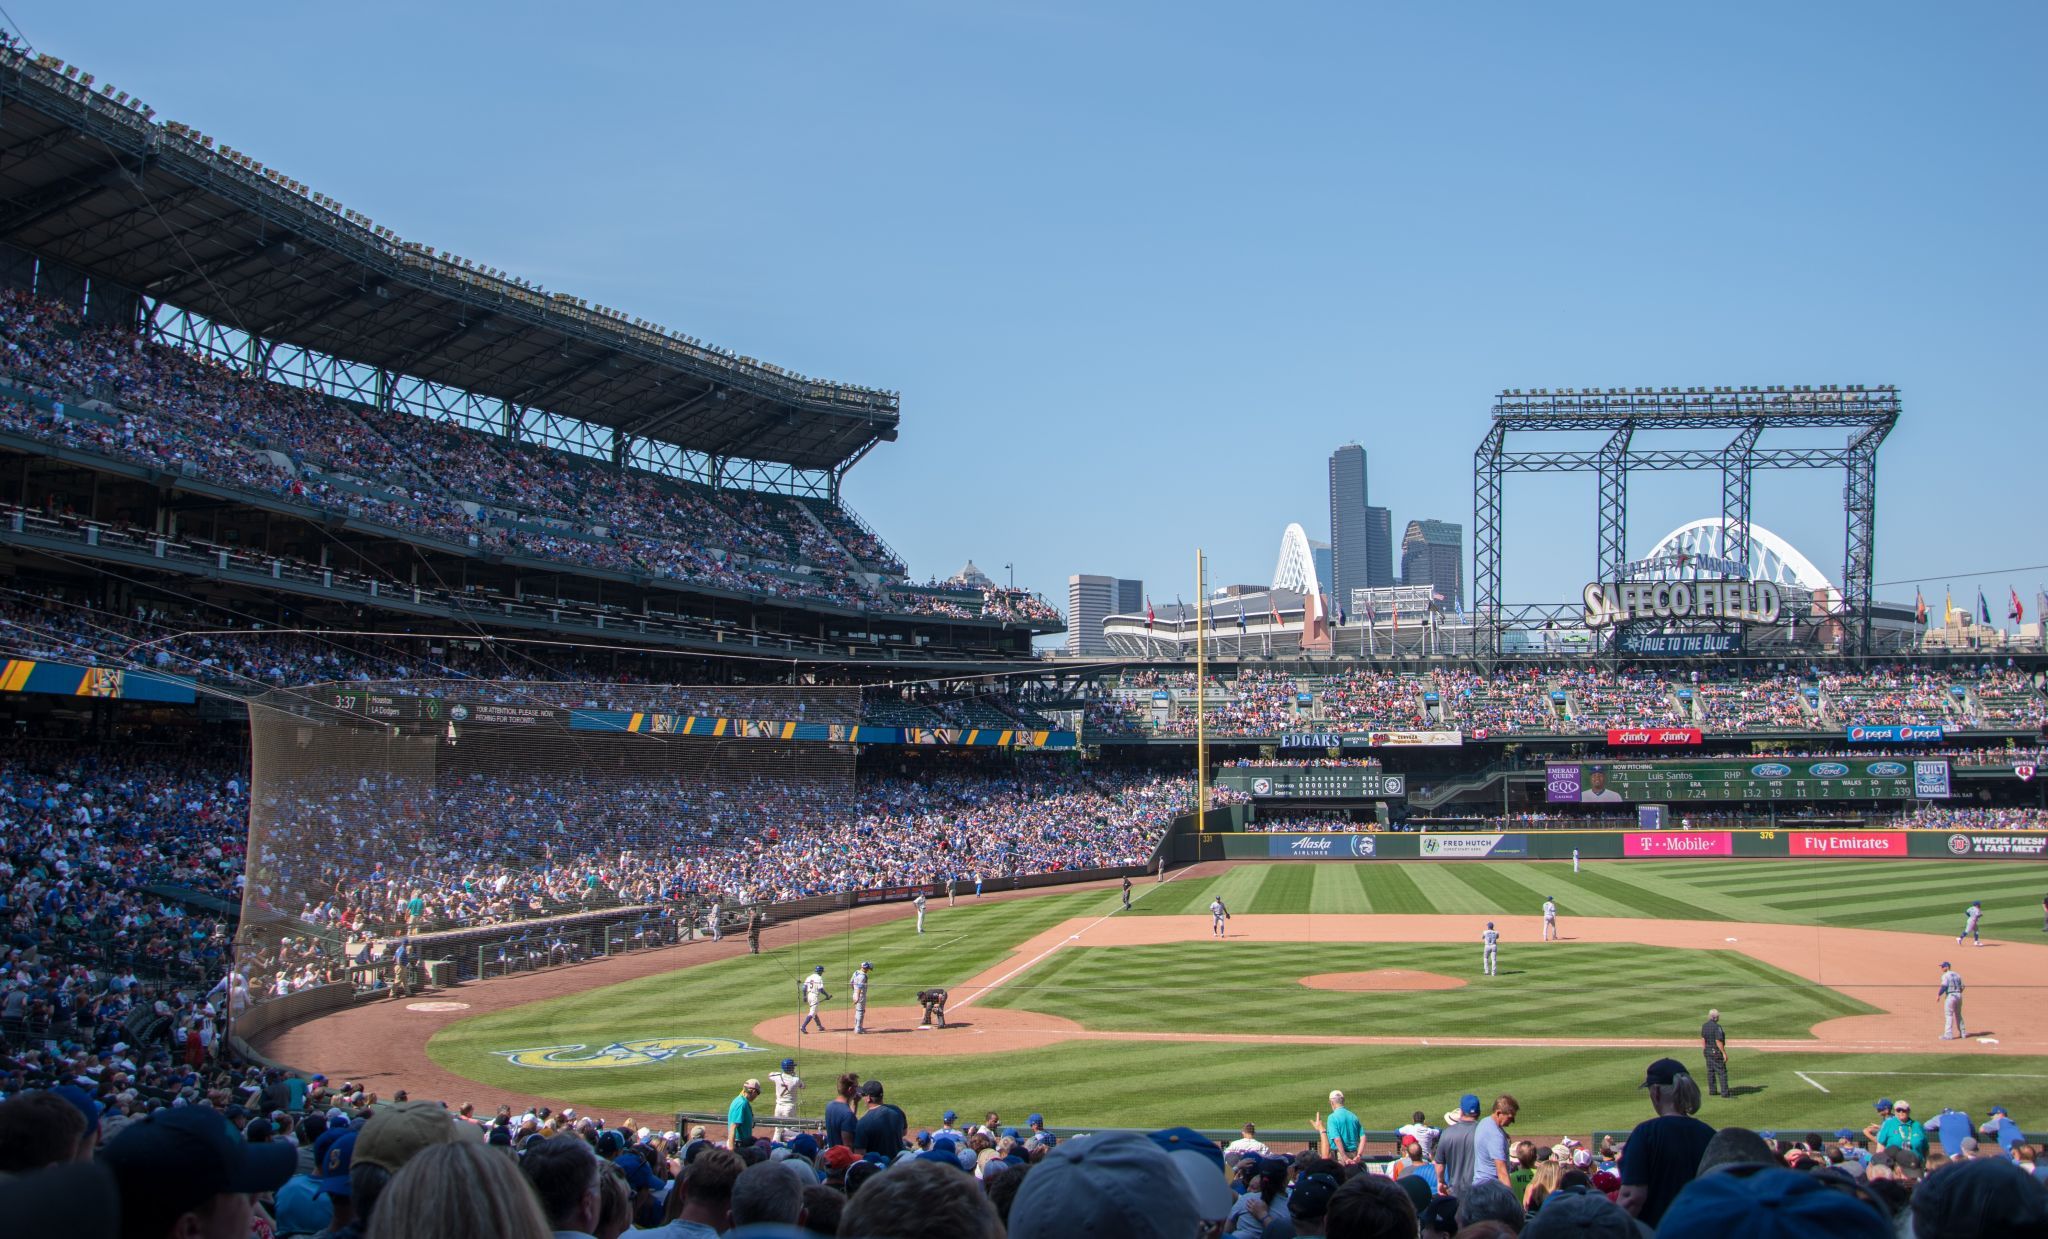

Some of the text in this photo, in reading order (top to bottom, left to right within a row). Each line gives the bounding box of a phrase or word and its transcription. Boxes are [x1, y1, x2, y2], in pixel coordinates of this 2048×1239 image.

[1613, 553, 1749, 579] SEATTLE MARINERS
[1583, 580, 1780, 629] SAFECO FIELD
[1639, 634, 1731, 651] TRUE TO THE BLUE
[335, 695, 356, 709] 3:37
[371, 695, 393, 704] Houston
[371, 706, 400, 716] LA Dodgers
[1619, 731, 1690, 743] xfinity xfinity
[1865, 729, 1892, 739] pepsi
[1913, 729, 1940, 739] pepsi
[1282, 734, 1340, 747] EDGARS
[1759, 765, 1783, 776] Ford
[1817, 764, 1841, 775] Ford
[1874, 764, 1898, 774] Ford
[1917, 765, 1944, 774] BUILT
[1612, 771, 1741, 780] #71 Luis Santos RHP
[1667, 790, 1672, 798] 0
[1687, 789, 1706, 798] 7.24
[1724, 789, 1729, 797] 9
[1743, 788, 1761, 797] 13.2
[1771, 788, 1781, 797] 19
[1797, 788, 1806, 797] 11
[1823, 788, 1828, 797] 2
[1849, 788, 1855, 796] 6
[1871, 788, 1880, 796] 17
[1892, 787, 1911, 796] .339
[1918, 785, 1946, 793] TOUGH
[1291, 836, 1332, 849] Alaska
[1805, 837, 1889, 851] Fly Emirates
[1971, 836, 2046, 845] WHERE FRESH
[2012, 845, 2042, 853] MEET
